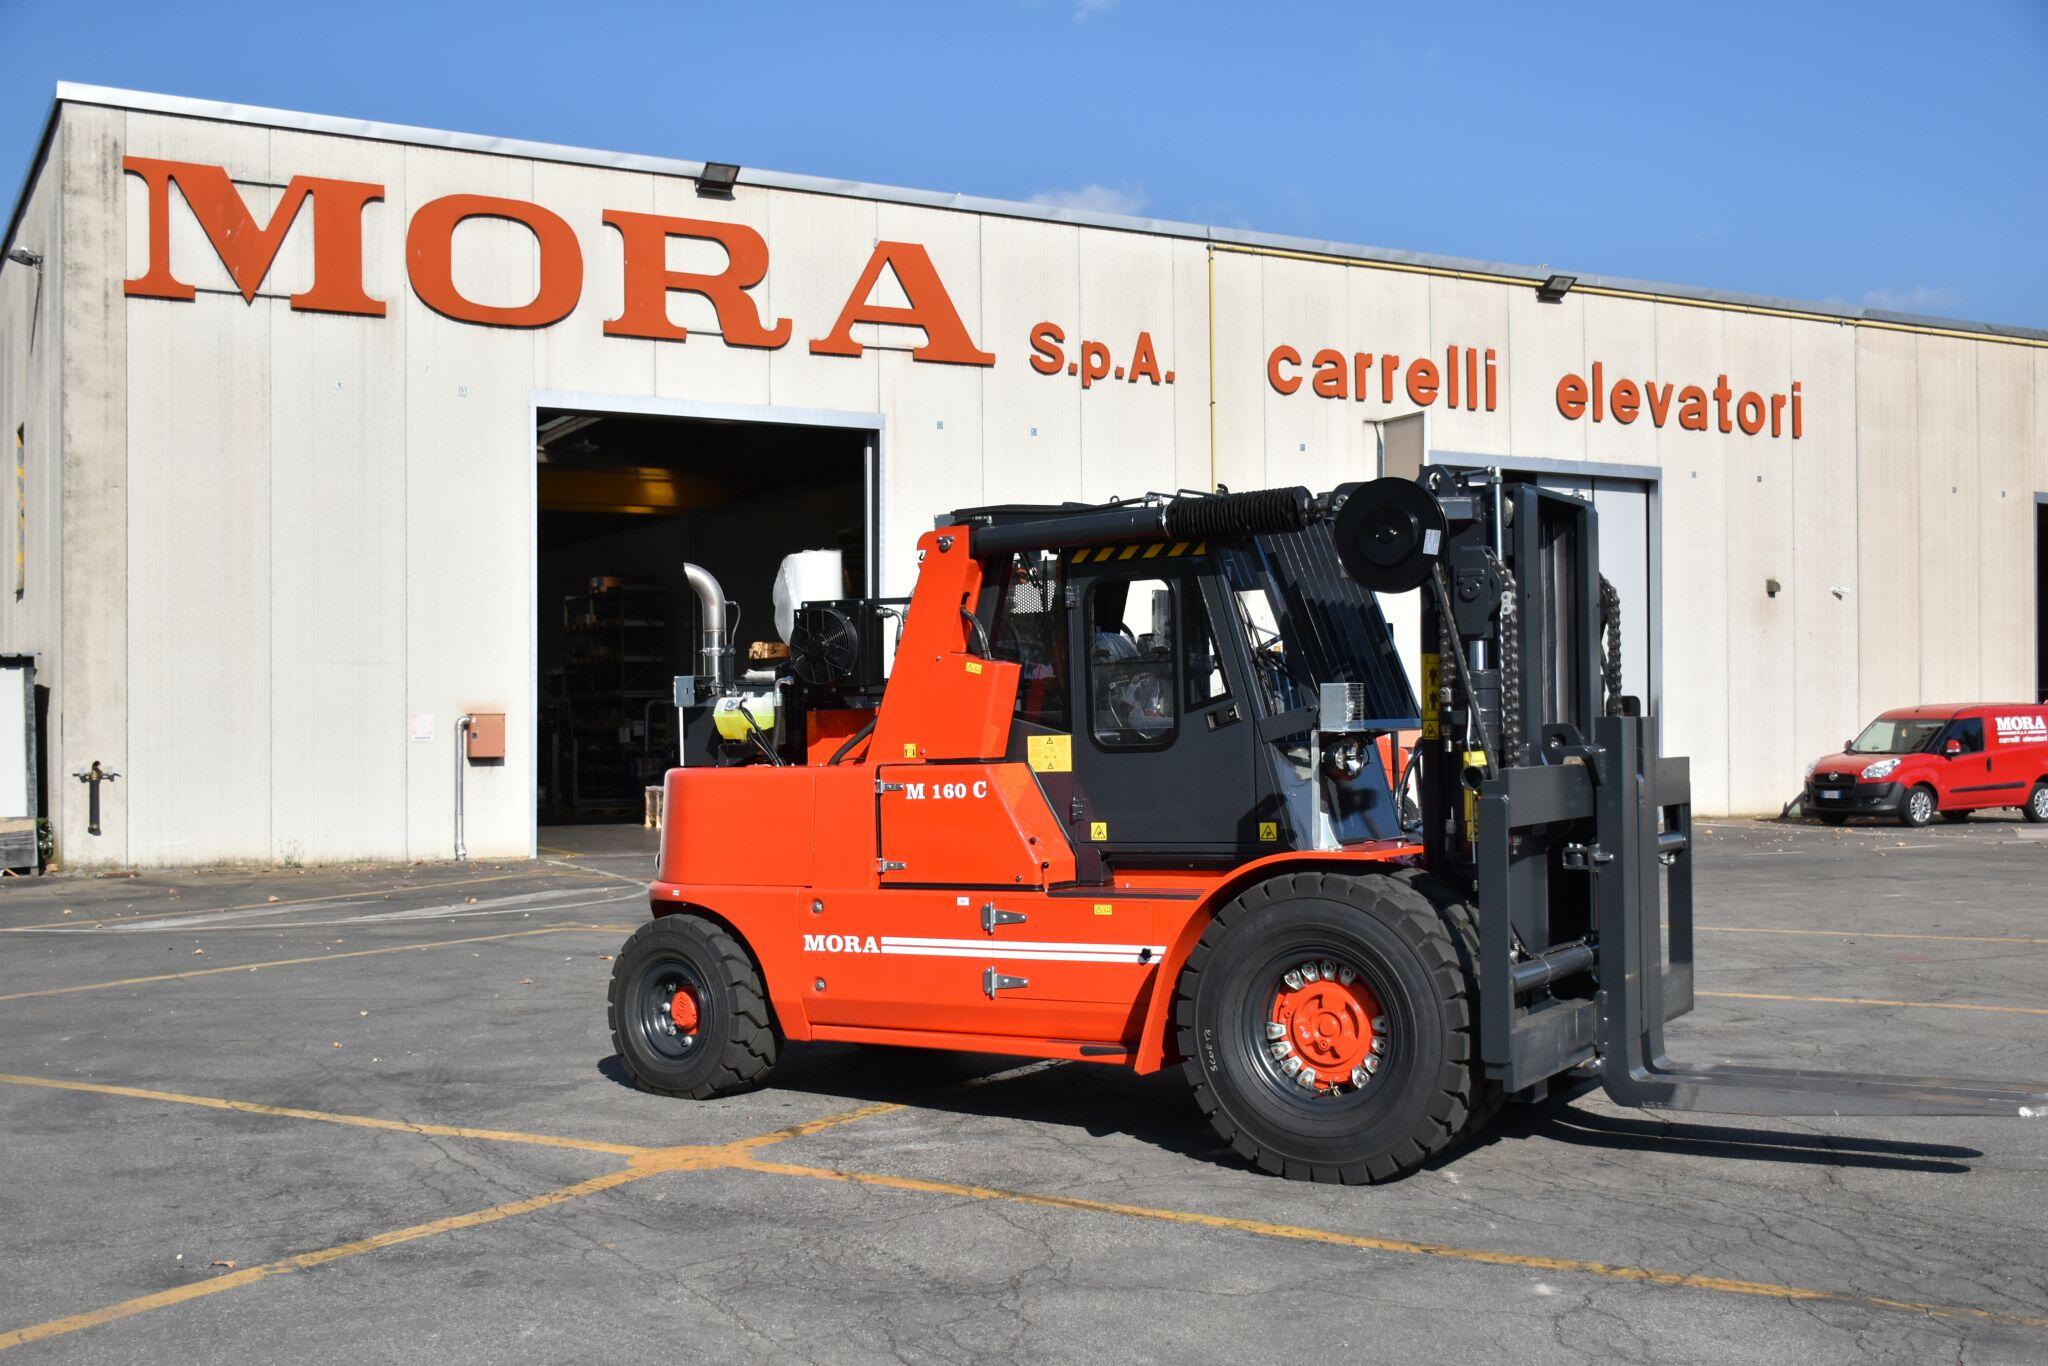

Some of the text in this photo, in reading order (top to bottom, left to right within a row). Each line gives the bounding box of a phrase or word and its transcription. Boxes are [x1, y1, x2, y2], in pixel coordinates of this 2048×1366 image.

[122, 156, 1803, 439] MORA S.p.A. carrelli elevatori
[1995, 716, 2046, 730] MORA
[905, 780, 987, 800] M 160 C
[803, 934, 881, 954] MORA
